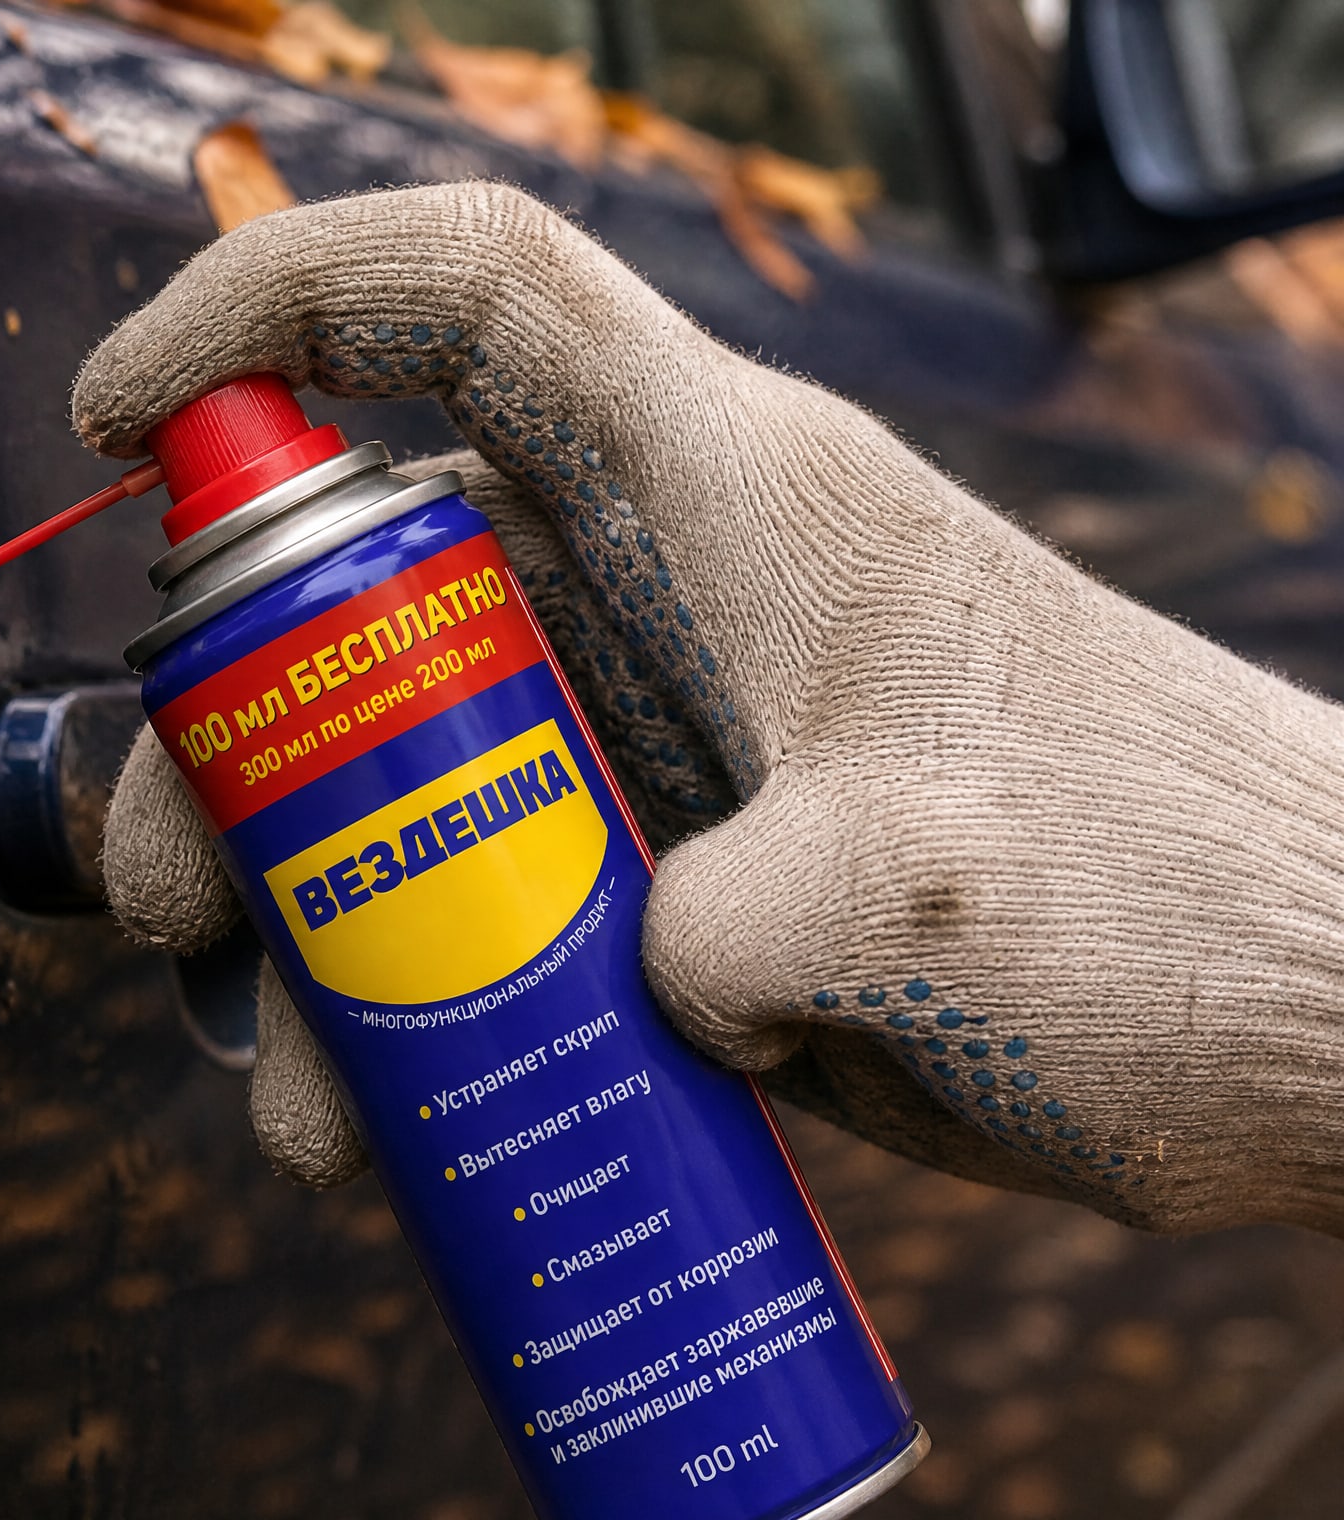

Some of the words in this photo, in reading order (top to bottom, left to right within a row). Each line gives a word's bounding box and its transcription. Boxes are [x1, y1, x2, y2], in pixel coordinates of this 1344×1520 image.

[179, 711, 233, 768] 100
[234, 686, 289, 737] мл
[285, 566, 506, 705] БЕСПЛАТНО
[239, 748, 282, 786] 300
[285, 732, 319, 763] мл
[320, 713, 351, 743] по
[356, 678, 416, 724] цене
[415, 648, 464, 691] 200
[466, 636, 497, 666] мл
[291, 749, 578, 933] ВЕЗДЕШКА
[362, 943, 571, 1029] МНОГОФУНКЦИОНАЛЬНЫЙ
[432, 1045, 548, 1116] Устраняет
[552, 1010, 620, 1057] скрип
[459, 1104, 582, 1178] Вытесняет
[585, 1069, 651, 1116] влагу
[529, 1154, 630, 1216] Очищает
[547, 1208, 671, 1282] Смазывает
[524, 1295, 644, 1366] Защищает
[647, 1280, 673, 1306] от
[677, 1226, 779, 1291] коррозии
[535, 1351, 680, 1433] Освобождает
[683, 1277, 825, 1364] заржавевшие
[550, 1444, 567, 1465] и
[570, 1374, 714, 1457] заклинившие
[715, 1307, 837, 1386] механизмы
[680, 1444, 736, 1488] 100
[739, 1423, 779, 1462] ml
